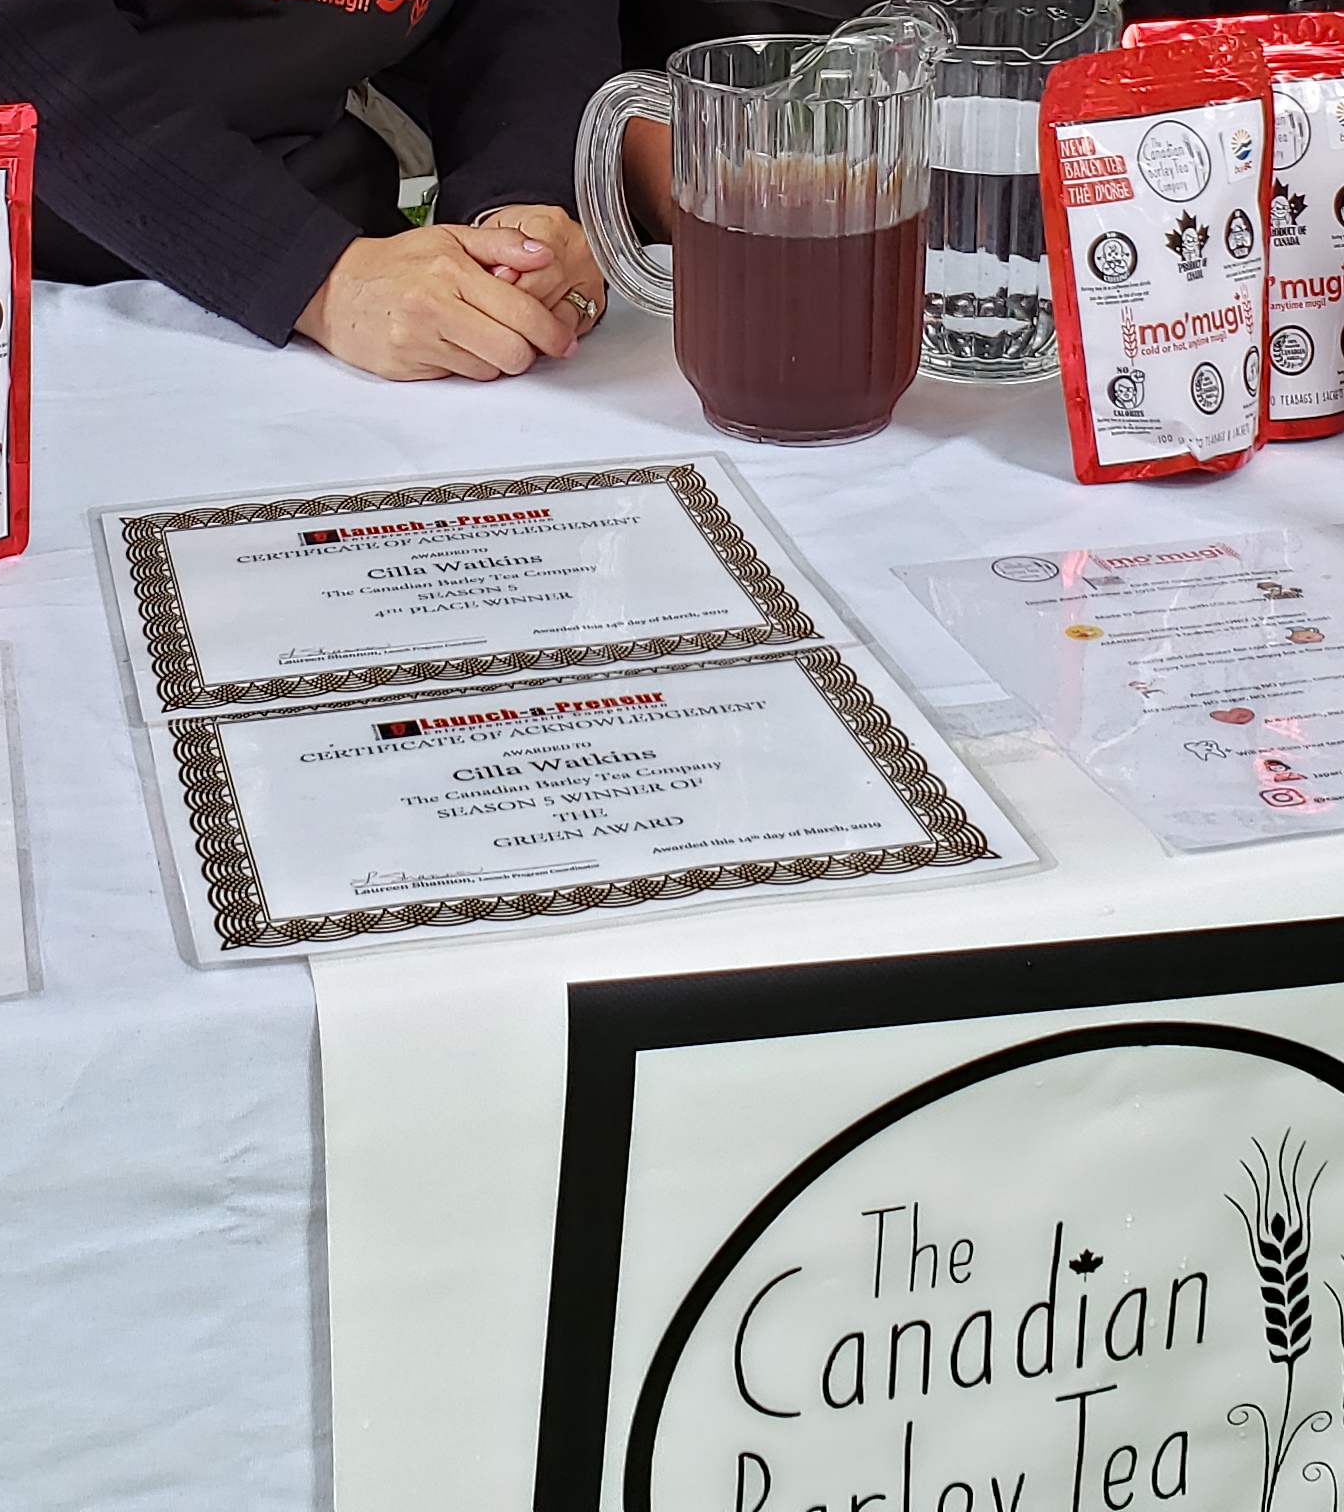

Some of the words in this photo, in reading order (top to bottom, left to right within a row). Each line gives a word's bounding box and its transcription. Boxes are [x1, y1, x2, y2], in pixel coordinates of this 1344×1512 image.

[1064, 159, 1101, 179] BARLEY
[1067, 184, 1091, 204] THÉ
[1138, 292, 1244, 345] mo'mugi
[339, 508, 551, 538] Launch-a-Preneur
[236, 541, 380, 564] CERTIFICATE
[383, 538, 413, 548] OF
[418, 516, 642, 545] ACKNOWLEDGEMENT
[321, 589, 355, 599] The
[359, 582, 433, 595] Canadian
[438, 575, 486, 587] Barley
[489, 572, 520, 581] Tea
[523, 564, 598, 578] Company
[367, 565, 428, 580] Cilla
[433, 554, 543, 573] Watkins
[410, 601, 480, 615] PLACE
[482, 591, 574, 607] WINNER
[417, 585, 502, 601] SEASON
[507, 584, 519, 592] 5
[419, 691, 663, 730] Launch-a-Preneur
[299, 734, 465, 763] CERTIFICATE
[469, 729, 502, 742] OF
[510, 699, 767, 737] ACKNOWLEDGEMENT
[452, 764, 523, 782] Cilla
[528, 749, 657, 773] Watkins
[502, 744, 570, 758] AWARDED
[570, 741, 592, 750] TO
[400, 794, 439, 806] The
[444, 783, 531, 801] Canadian
[536, 775, 591, 790] Barley
[594, 771, 632, 781] Tea
[635, 760, 723, 777] Company
[436, 797, 537, 819] SEASON
[543, 795, 556, 807] 5
[560, 781, 664, 804] WINNER
[669, 777, 704, 789] OF
[492, 828, 584, 848] GREEN
[593, 815, 685, 836] AWARD
[552, 807, 608, 823] THE
[652, 839, 708, 854] Awarded
[709, 836, 735, 847] this
[763, 831, 786, 842] day
[787, 828, 802, 838] of
[803, 824, 849, 836] March,
[851, 821, 882, 830] 2019
[354, 883, 409, 896] Laureen
[861, 1201, 975, 1299] The
[733, 1220, 1209, 1419] Canadian
[1055, 1383, 1189, 1512] Tea
